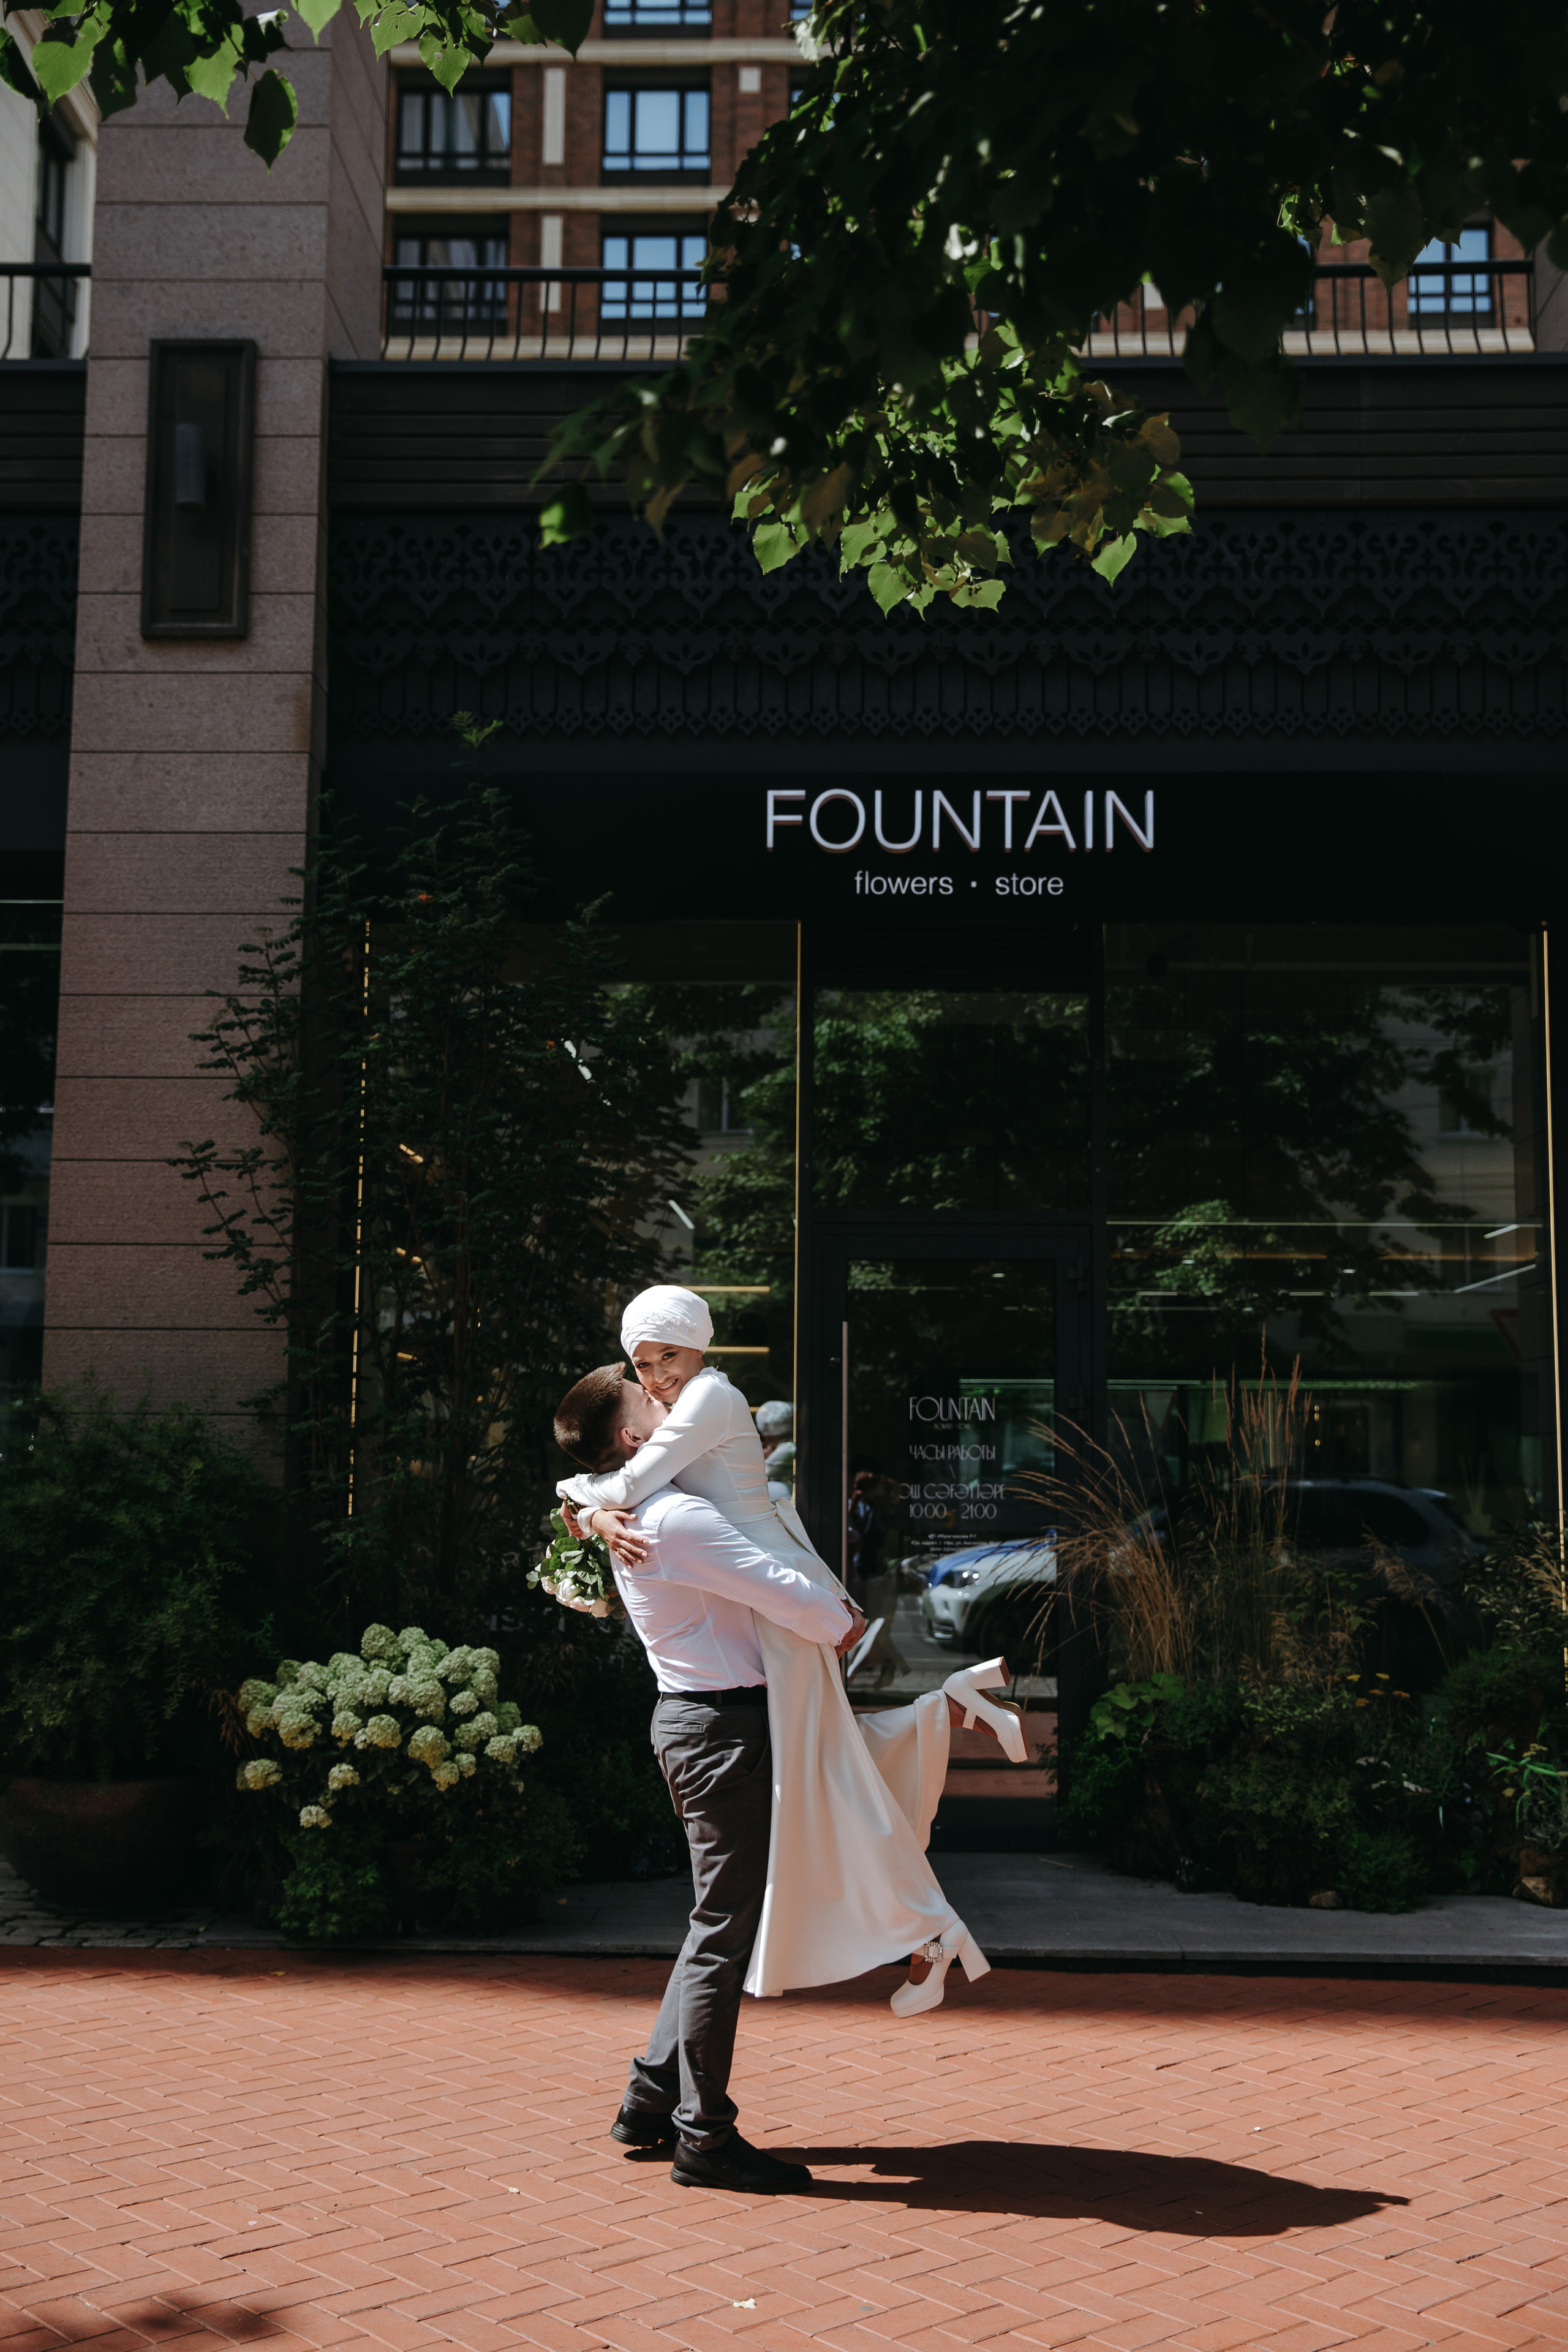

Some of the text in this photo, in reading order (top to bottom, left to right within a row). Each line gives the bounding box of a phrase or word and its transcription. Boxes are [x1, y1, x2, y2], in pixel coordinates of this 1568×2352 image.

[766, 788, 1154, 853] FOUNTAIN
[854, 870, 953, 895] flowers
[995, 873, 1064, 895] store
[909, 1396, 995, 1422] FOUNTAIN
[909, 1444, 996, 1460] ЧАСЫ РАБОТЫ
[899, 1483, 921, 1499] ЭШ
